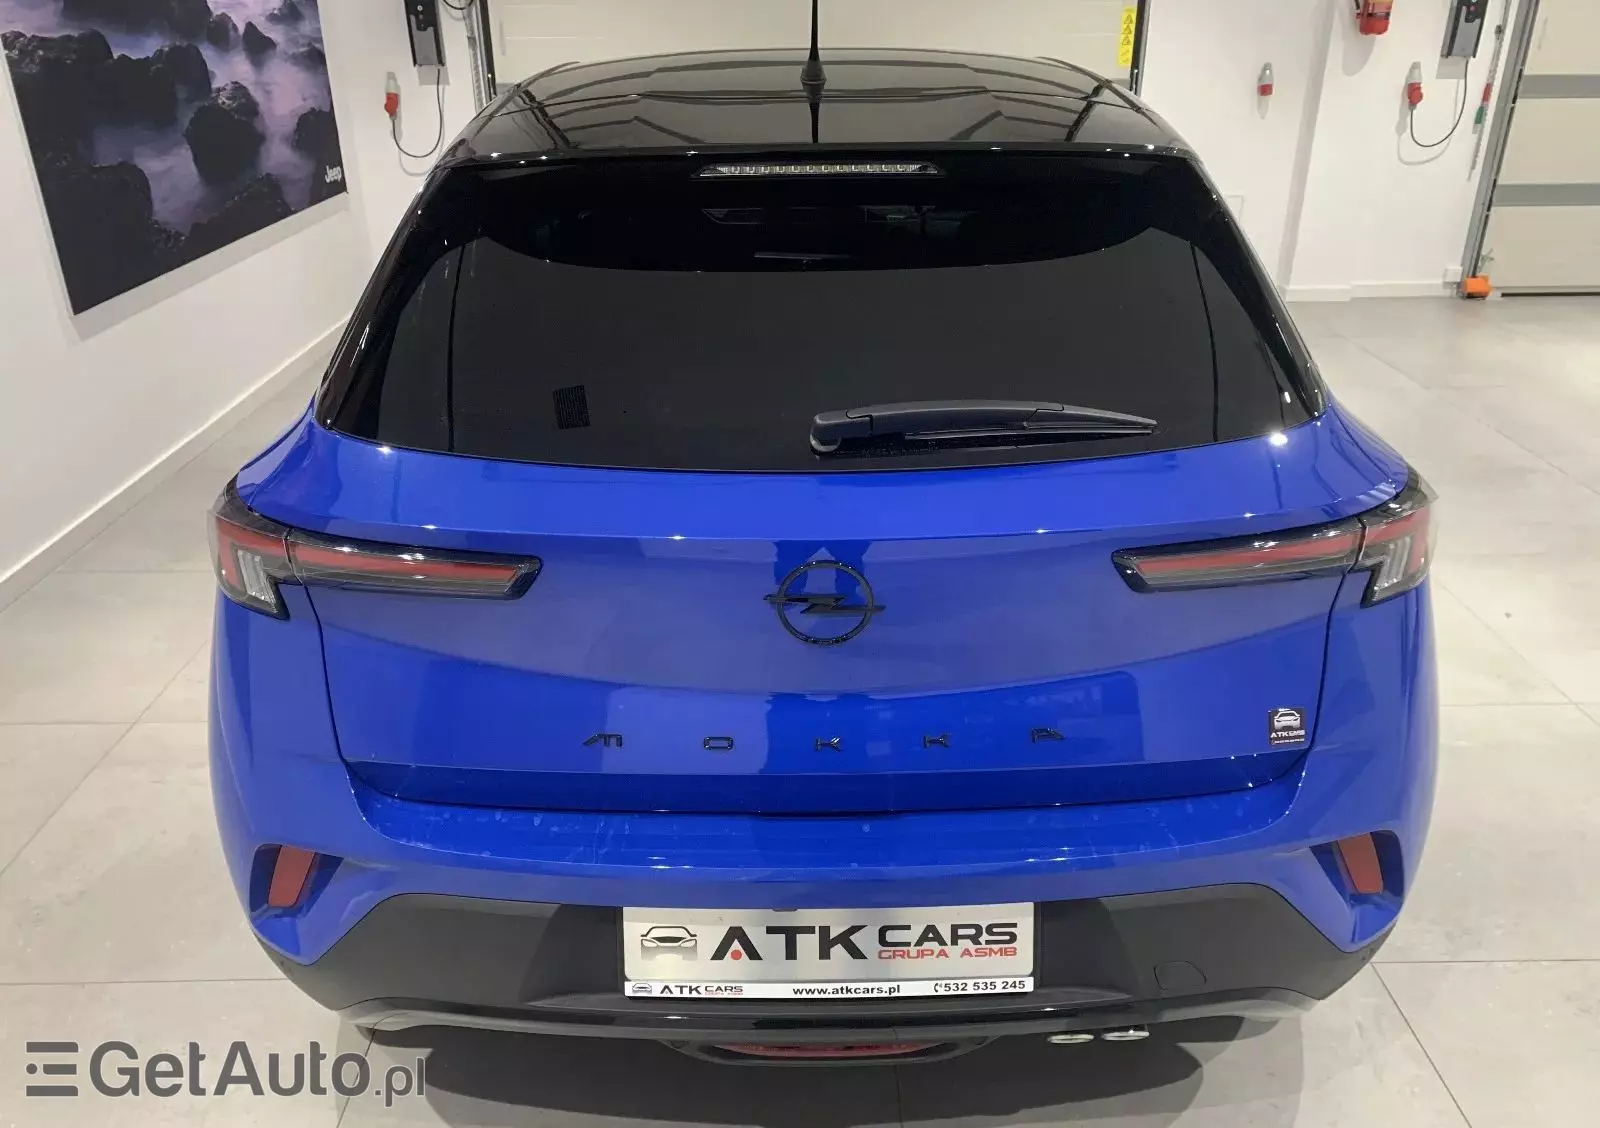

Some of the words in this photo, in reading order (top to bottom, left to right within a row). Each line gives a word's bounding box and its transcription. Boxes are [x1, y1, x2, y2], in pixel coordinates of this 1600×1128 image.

[325, 165, 342, 183] Jeep
[710, 925, 868, 961] ATK
[878, 923, 1018, 947] CARS
[878, 949, 950, 960] GRUPA
[960, 947, 1017, 958] ASMB
[660, 985, 702, 995] ATK
[705, 985, 743, 993] CARS
[792, 984, 901, 996] www.atkcars.pl
[944, 982, 968, 992] 532
[973, 981, 997, 991] 535
[1002, 980, 1026, 990] 245
